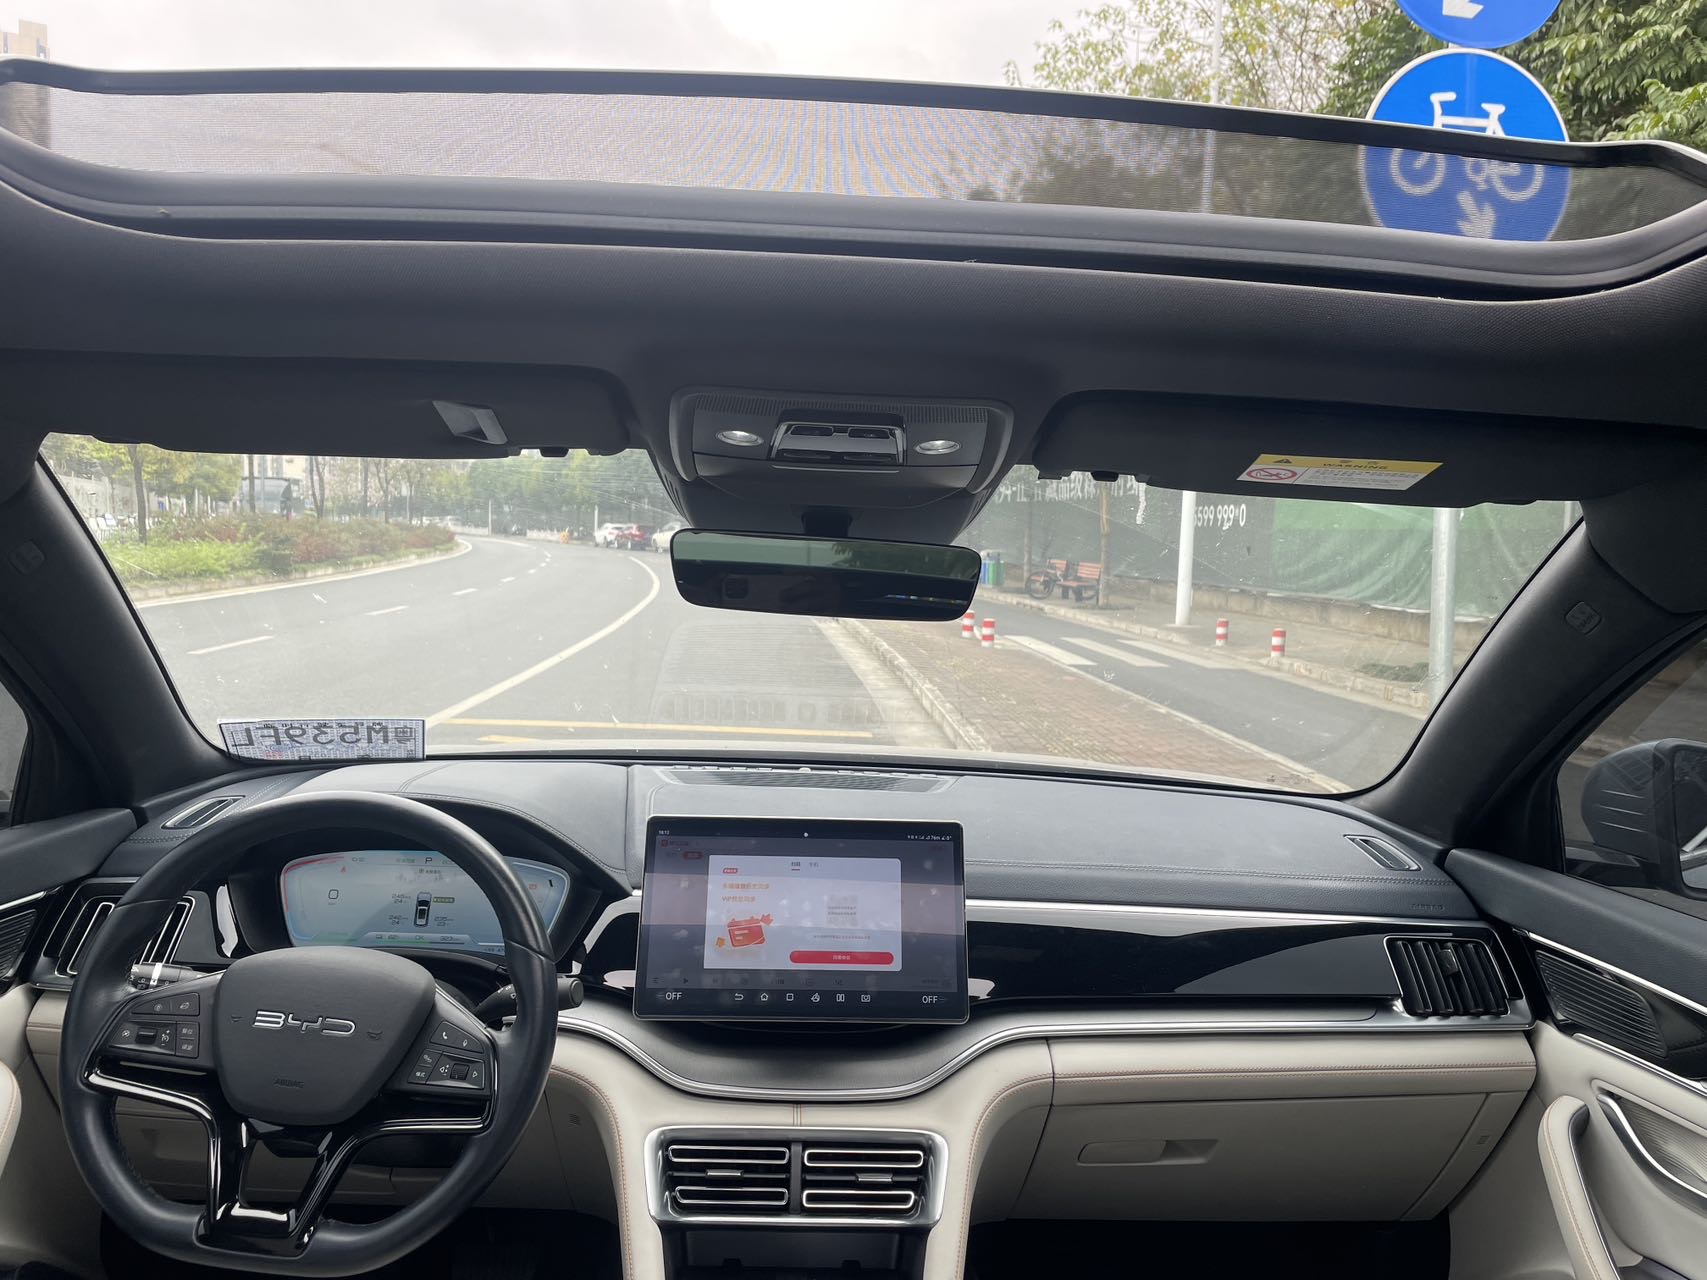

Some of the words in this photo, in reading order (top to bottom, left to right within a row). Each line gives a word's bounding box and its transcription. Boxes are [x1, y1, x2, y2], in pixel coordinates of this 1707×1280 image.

[424, 856, 433, 864] P
[665, 991, 683, 1001] OFF
[922, 995, 938, 1004] OFF
[252, 1009, 357, 1037] BYD
